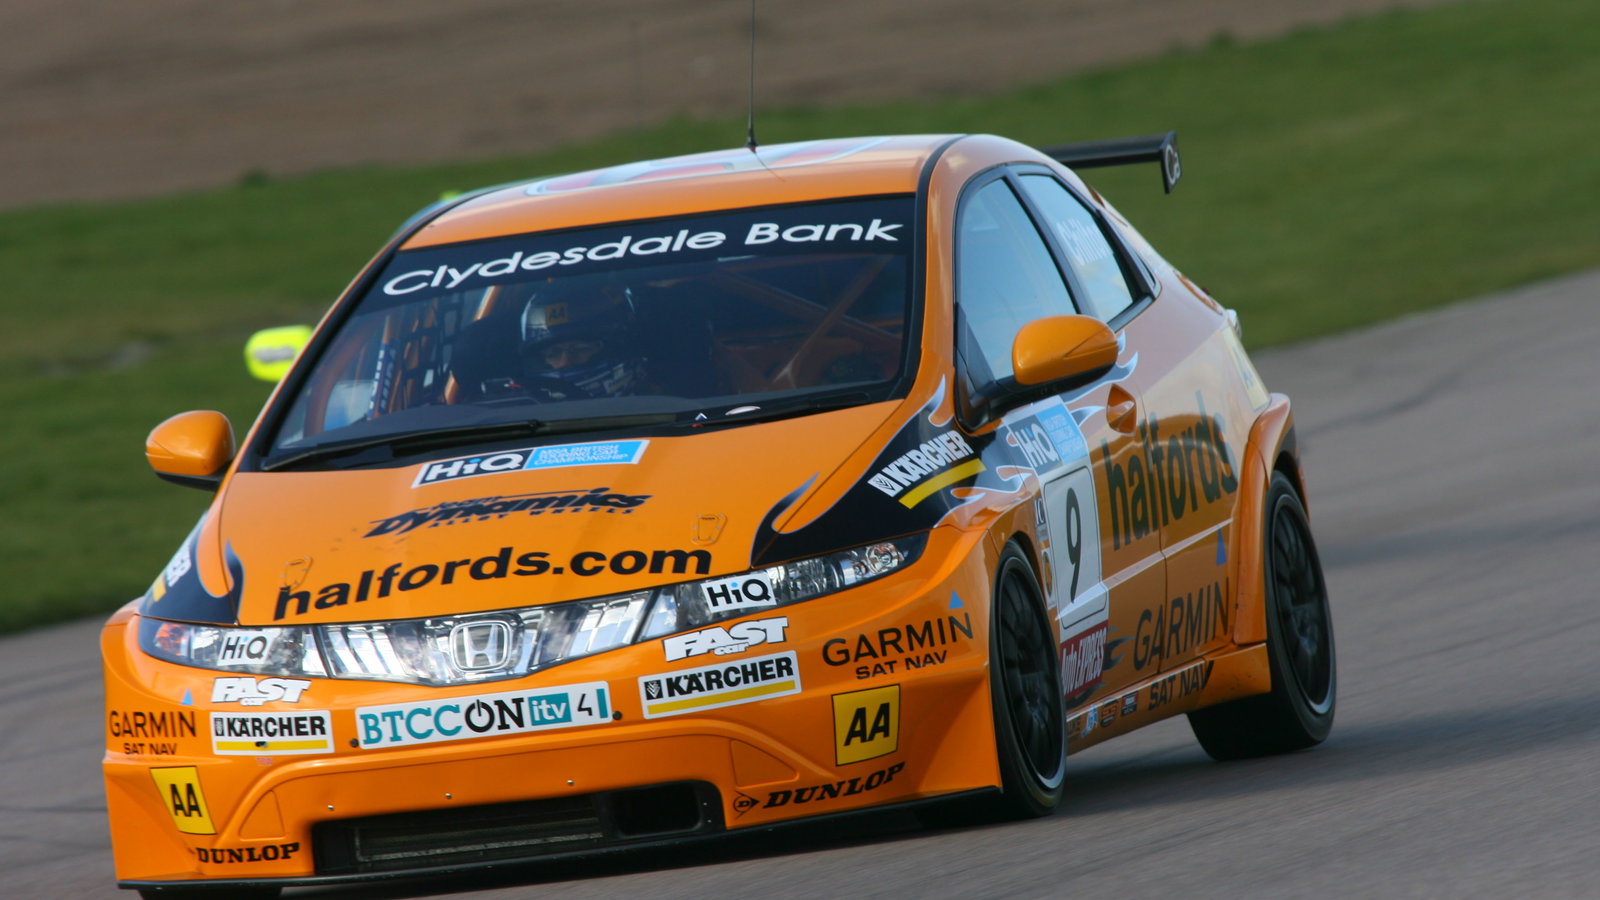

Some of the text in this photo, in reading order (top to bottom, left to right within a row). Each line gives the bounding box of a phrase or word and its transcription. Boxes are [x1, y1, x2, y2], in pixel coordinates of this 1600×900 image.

[382, 219, 904, 296] Clydesdale Bank
[882, 430, 974, 487] KÄRCHER
[1015, 423, 1060, 468] HiQ
[424, 453, 524, 481] HiQ
[1102, 390, 1238, 551] halfords
[1066, 487, 1082, 604] 9
[273, 547, 712, 621] halfords.com
[707, 580, 772, 607] HiQ
[662, 617, 789, 662] FAST
[822, 613, 974, 667] GARMIN
[1133, 577, 1230, 671] GARMIN
[222, 635, 268, 661] HiQ
[713, 642, 749, 655] car
[855, 650, 947, 680] SAT NAV
[211, 677, 312, 703] FAST
[666, 657, 794, 697] KÄRCHER
[1148, 674, 1177, 711] SAT
[1179, 660, 1214, 699] NAV
[109, 711, 197, 738] GARMIN
[227, 716, 326, 737] KÄRCHER
[360, 704, 462, 745] BTCC
[843, 701, 892, 747] AA
[123, 742, 178, 755] SAT NAV
[169, 783, 203, 818] AA
[763, 762, 905, 809] DUNLOP
[196, 842, 299, 864] DUNLOP
